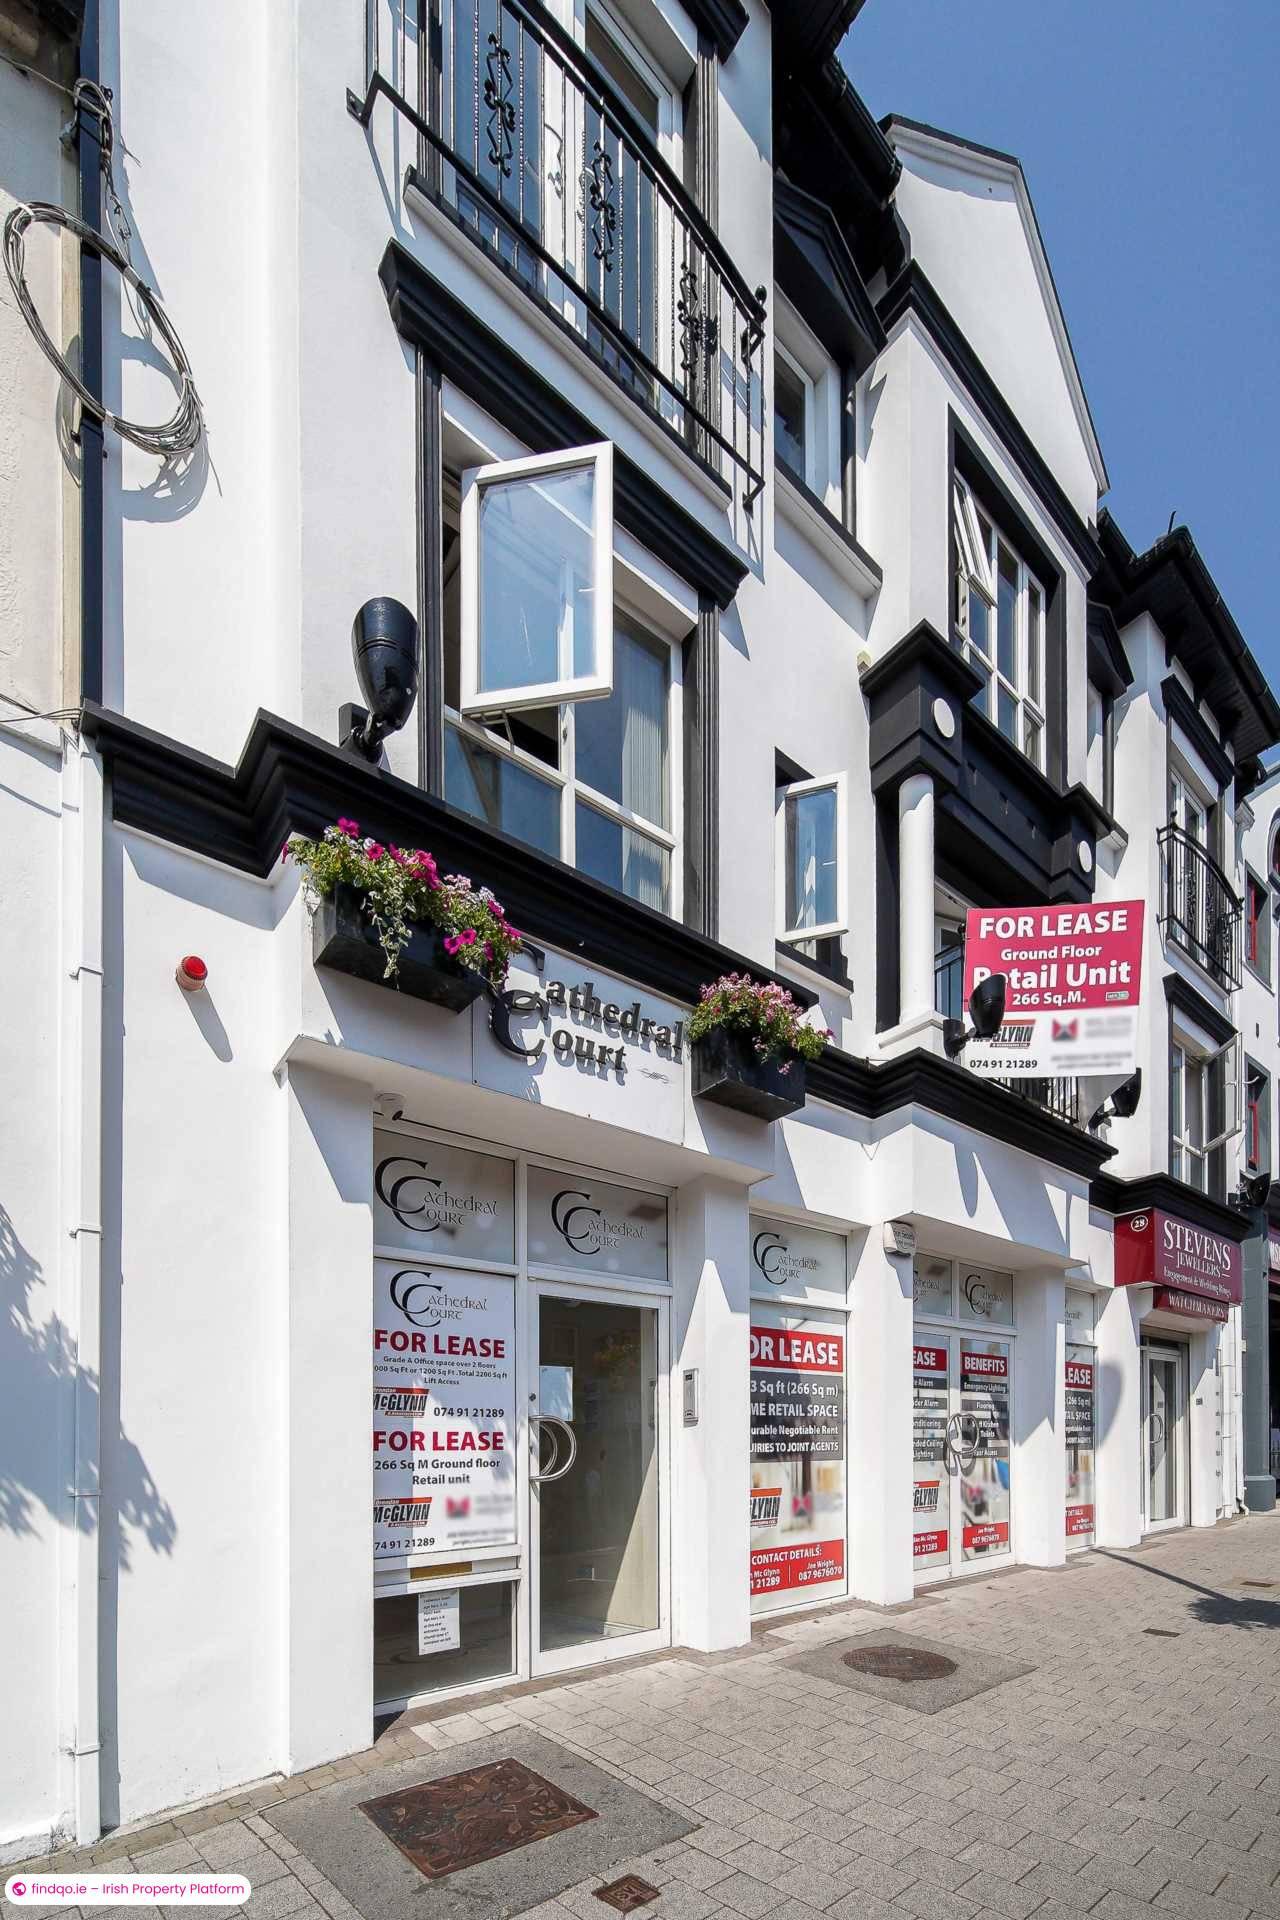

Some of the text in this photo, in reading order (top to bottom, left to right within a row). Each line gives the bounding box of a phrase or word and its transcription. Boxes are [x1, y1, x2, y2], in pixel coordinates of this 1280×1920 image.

[979, 909, 1129, 939] FOR LEASE
[1001, 945, 1102, 962] Ground Floor
[973, 960, 1132, 990] Rtail Unit
[1012, 991, 1087, 1006] 266 Sq.M.
[491, 989, 628, 1071] Court
[969, 1059, 1038, 1069] 074 91 21289
[1133, 1219, 1145, 1228] 28
[1163, 1219, 1231, 1271] STEVENS
[1176, 1251, 1221, 1278] JEWELLERS
[1168, 1291, 1225, 1318] WATCHMAKERS
[374, 1329, 505, 1359] FOR LEASE
[779, 1338, 839, 1366] LEASE
[383, 1355, 406, 1364] Grade
[414, 1357, 434, 1366] Office
[435, 1360, 455, 1369] space
[477, 1361, 496, 1369] floors
[964, 1356, 1005, 1373] BENEFITS
[389, 1366, 399, 1375] Sq
[419, 1367, 437, 1375] 1200
[1065, 1367, 1091, 1385] EASE
[424, 1377, 460, 1385] Lift Access
[760, 1380, 774, 1396] Sq
[776, 1380, 785, 1394] ft
[787, 1381, 810, 1396] (266
[811, 1383, 825, 1398] Sq
[434, 1407, 454, 1417] 074
[457, 1407, 469, 1418] 91
[472, 1408, 505, 1418] 21289
[768, 1402, 805, 1417] RETAIL
[807, 1404, 838, 1417] SPACE
[778, 1424, 820, 1437] Negotiable
[821, 1425, 839, 1435] Rent
[373, 1431, 504, 1451] FOR LEASE
[775, 1442, 787, 1452] TO
[787, 1442, 811, 1452] JOINT
[811, 1441, 839, 1452] AGENTS
[374, 1458, 501, 1472] 266 Sq M Ground floor
[412, 1474, 470, 1485] Retail unit
[373, 1503, 431, 1523] McGLYNN
[750, 1497, 780, 1520] LYNN
[405, 1538, 435, 1548] 21289
[751, 1551, 789, 1565] CONTACT
[756, 1575, 780, 1589] 21289
